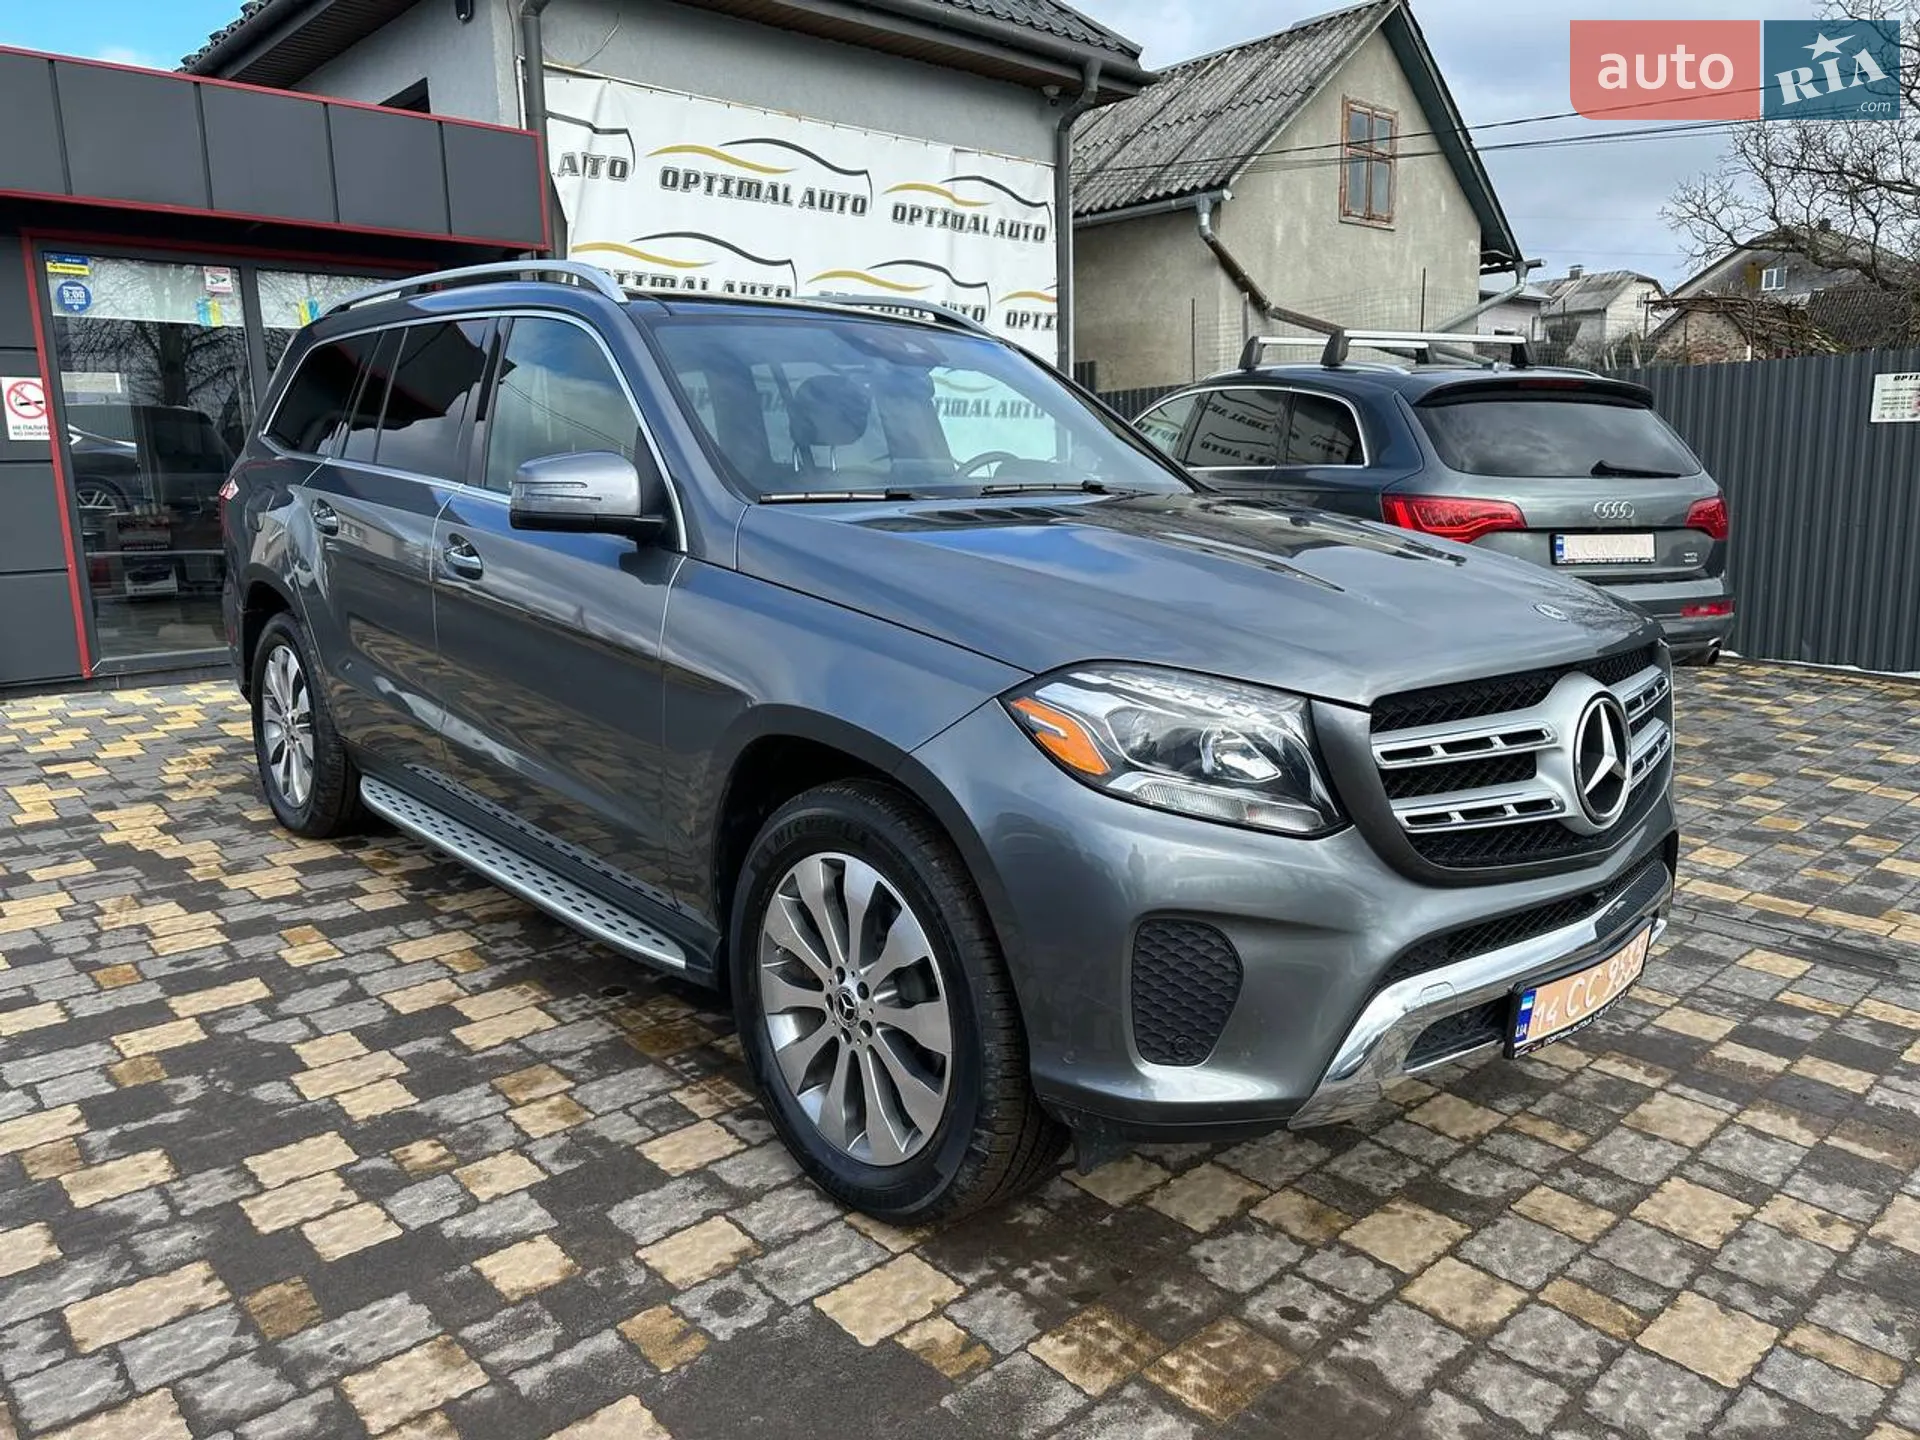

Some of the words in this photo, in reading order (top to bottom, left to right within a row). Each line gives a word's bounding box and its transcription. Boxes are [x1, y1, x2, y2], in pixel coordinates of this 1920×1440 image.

[660, 166, 793, 207] OPTIMAL
[799, 187, 868, 217] AUTO
[891, 202, 990, 236] OPTIMAL
[993, 217, 1047, 243] AUTO
[562, 268, 708, 292] TIMAL
